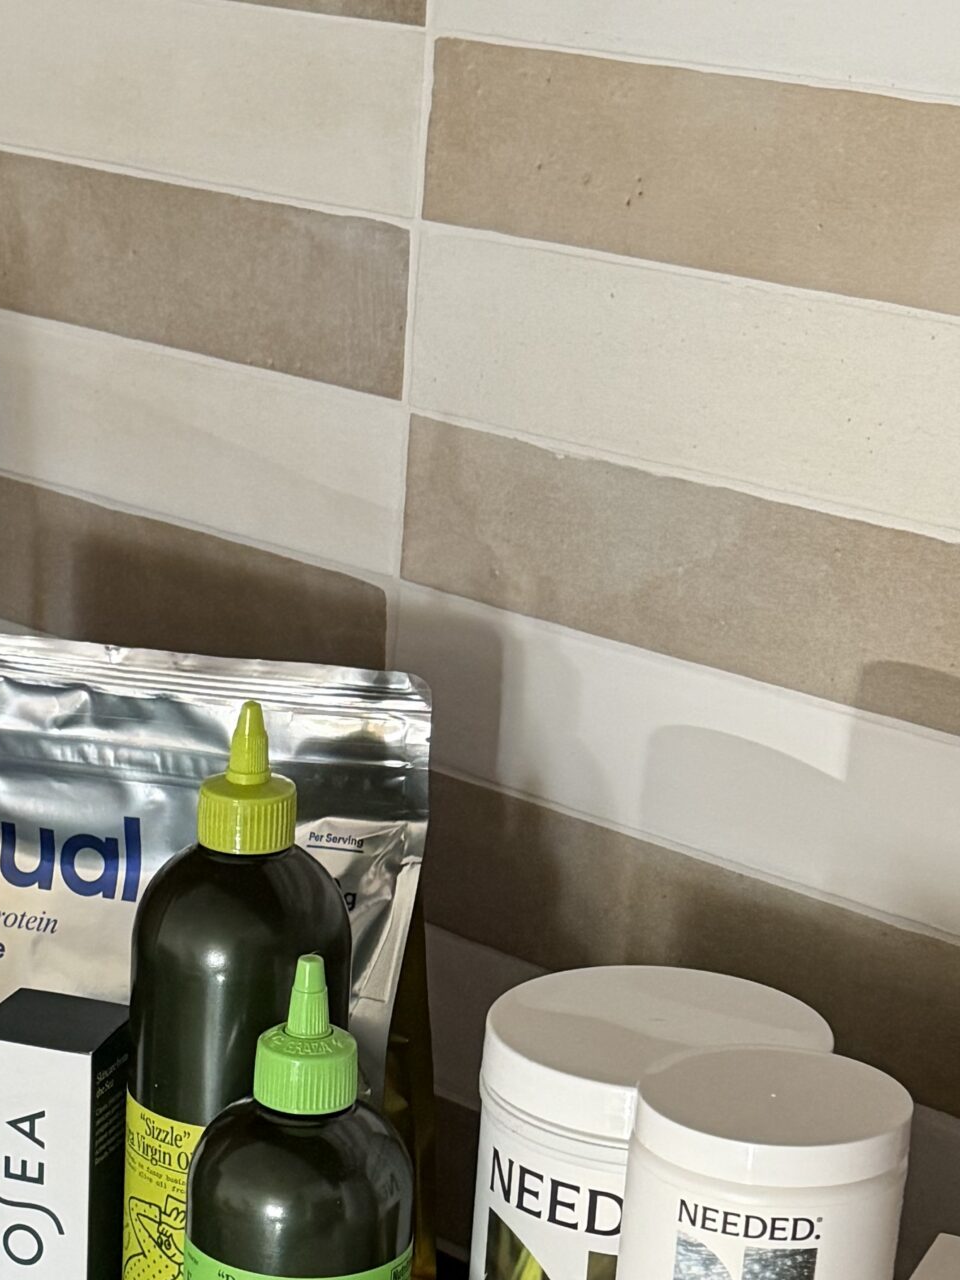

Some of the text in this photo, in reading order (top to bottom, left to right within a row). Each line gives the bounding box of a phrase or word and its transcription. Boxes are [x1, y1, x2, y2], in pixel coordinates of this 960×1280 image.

[308, 832, 364, 848] Per Serving
[136, 1131, 172, 1167] Virgin
[489, 1145, 624, 1237] NEED
